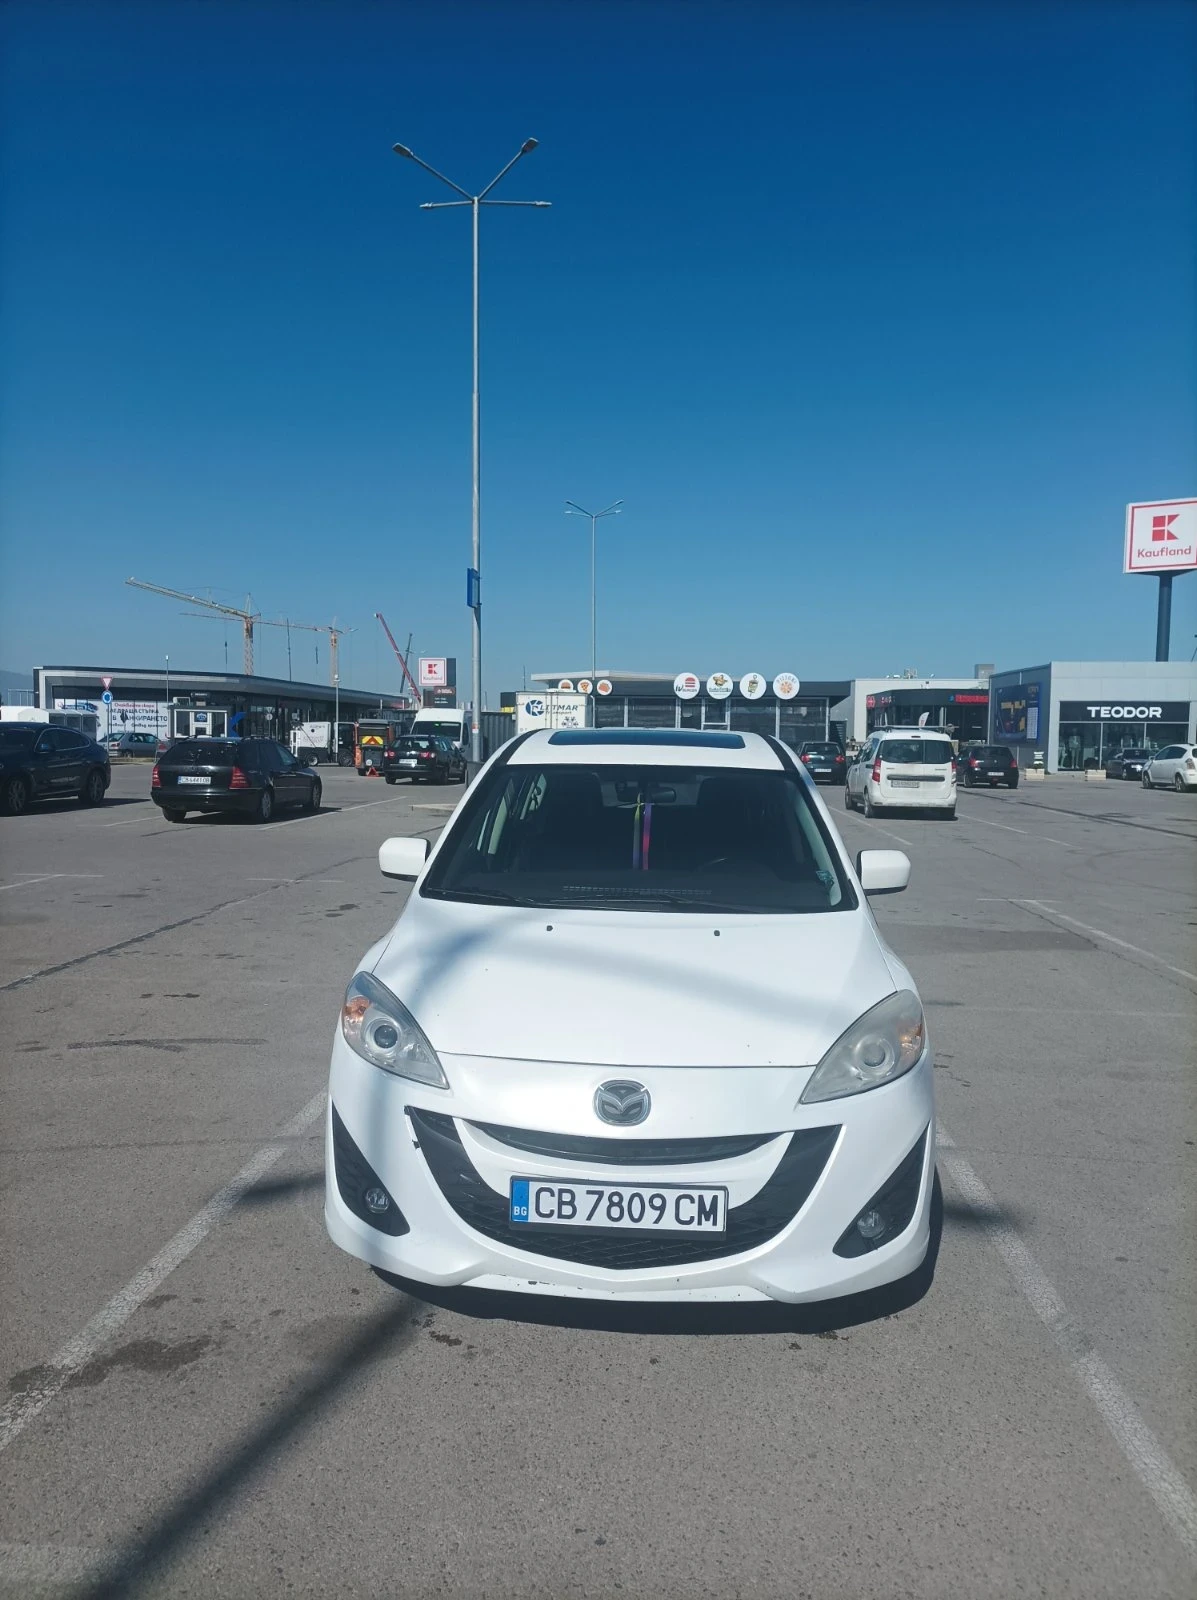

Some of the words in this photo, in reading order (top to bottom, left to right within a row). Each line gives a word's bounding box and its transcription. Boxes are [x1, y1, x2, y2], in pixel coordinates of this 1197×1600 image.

[1137, 545, 1192, 558] Kaufland
[1086, 706, 1162, 718] TEODOR
[513, 1206, 528, 1216] BG
[535, 1187, 577, 1219] CB
[585, 1190, 667, 1224] 7809
[674, 1194, 719, 1226] CM
